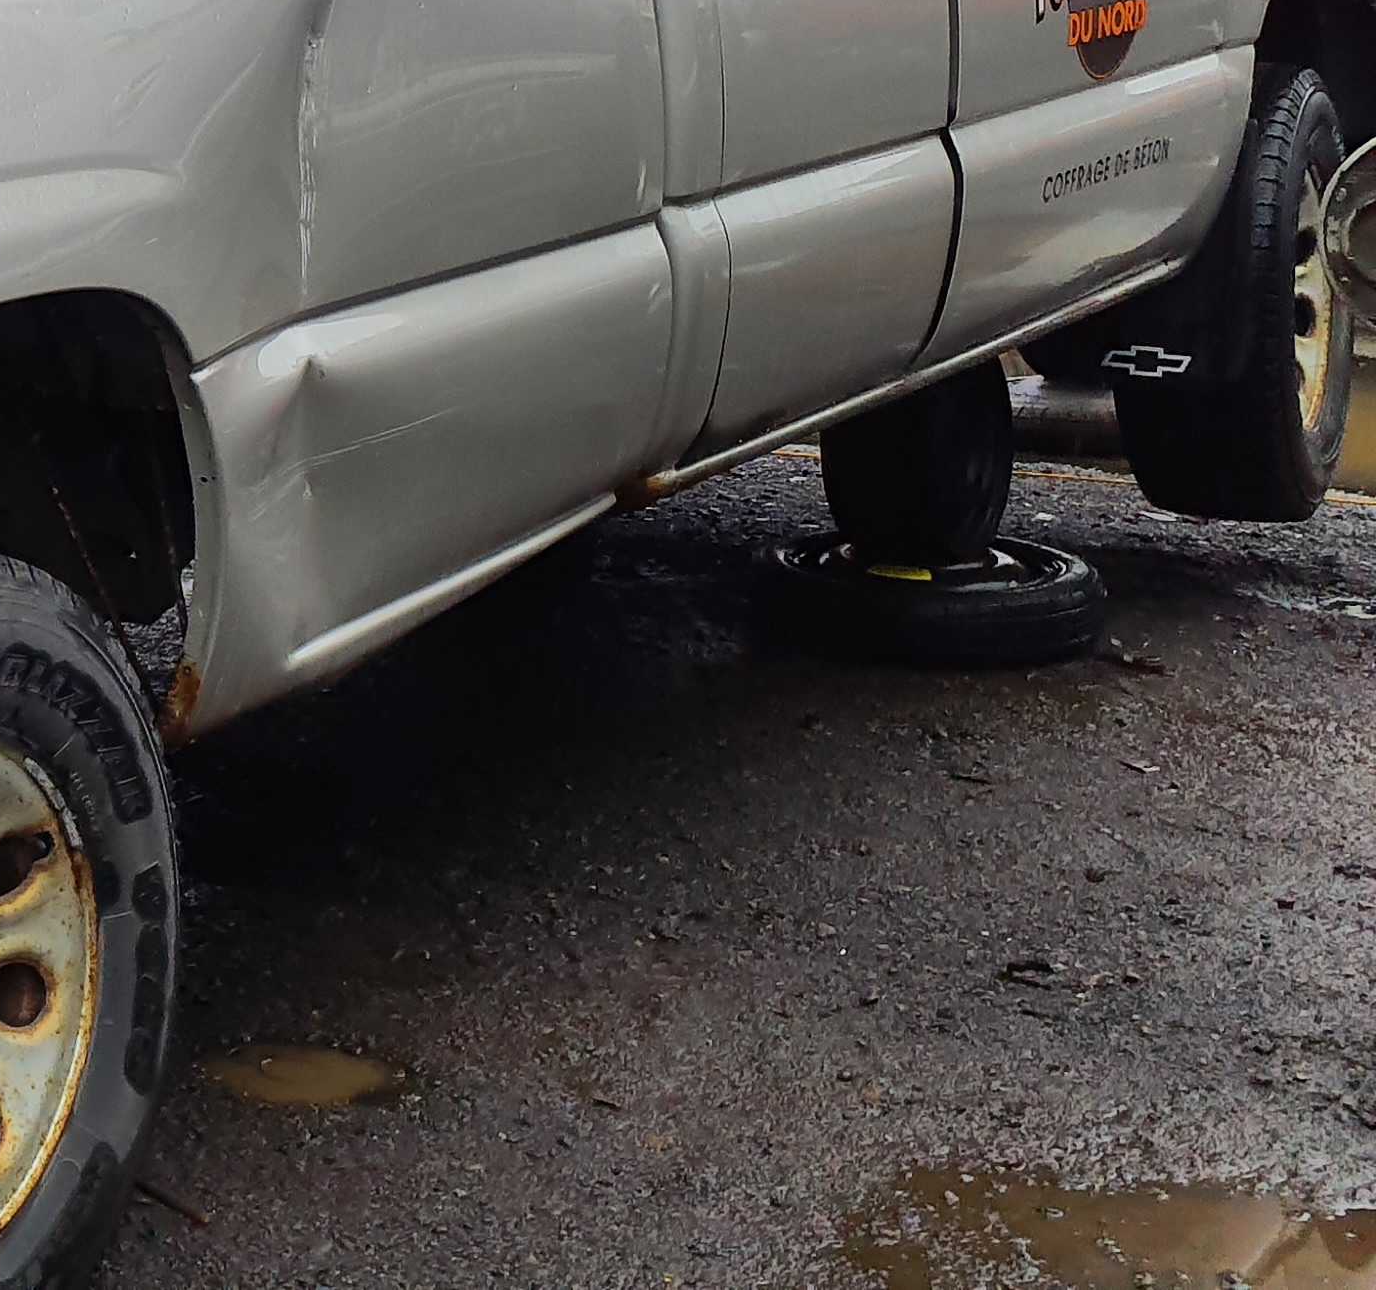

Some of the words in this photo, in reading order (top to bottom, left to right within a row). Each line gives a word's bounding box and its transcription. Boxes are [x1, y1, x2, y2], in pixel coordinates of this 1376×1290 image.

[1067, 8, 1096, 46] DU
[1042, 156, 1111, 203] COFFRAGE
[1114, 150, 1130, 177] DE
